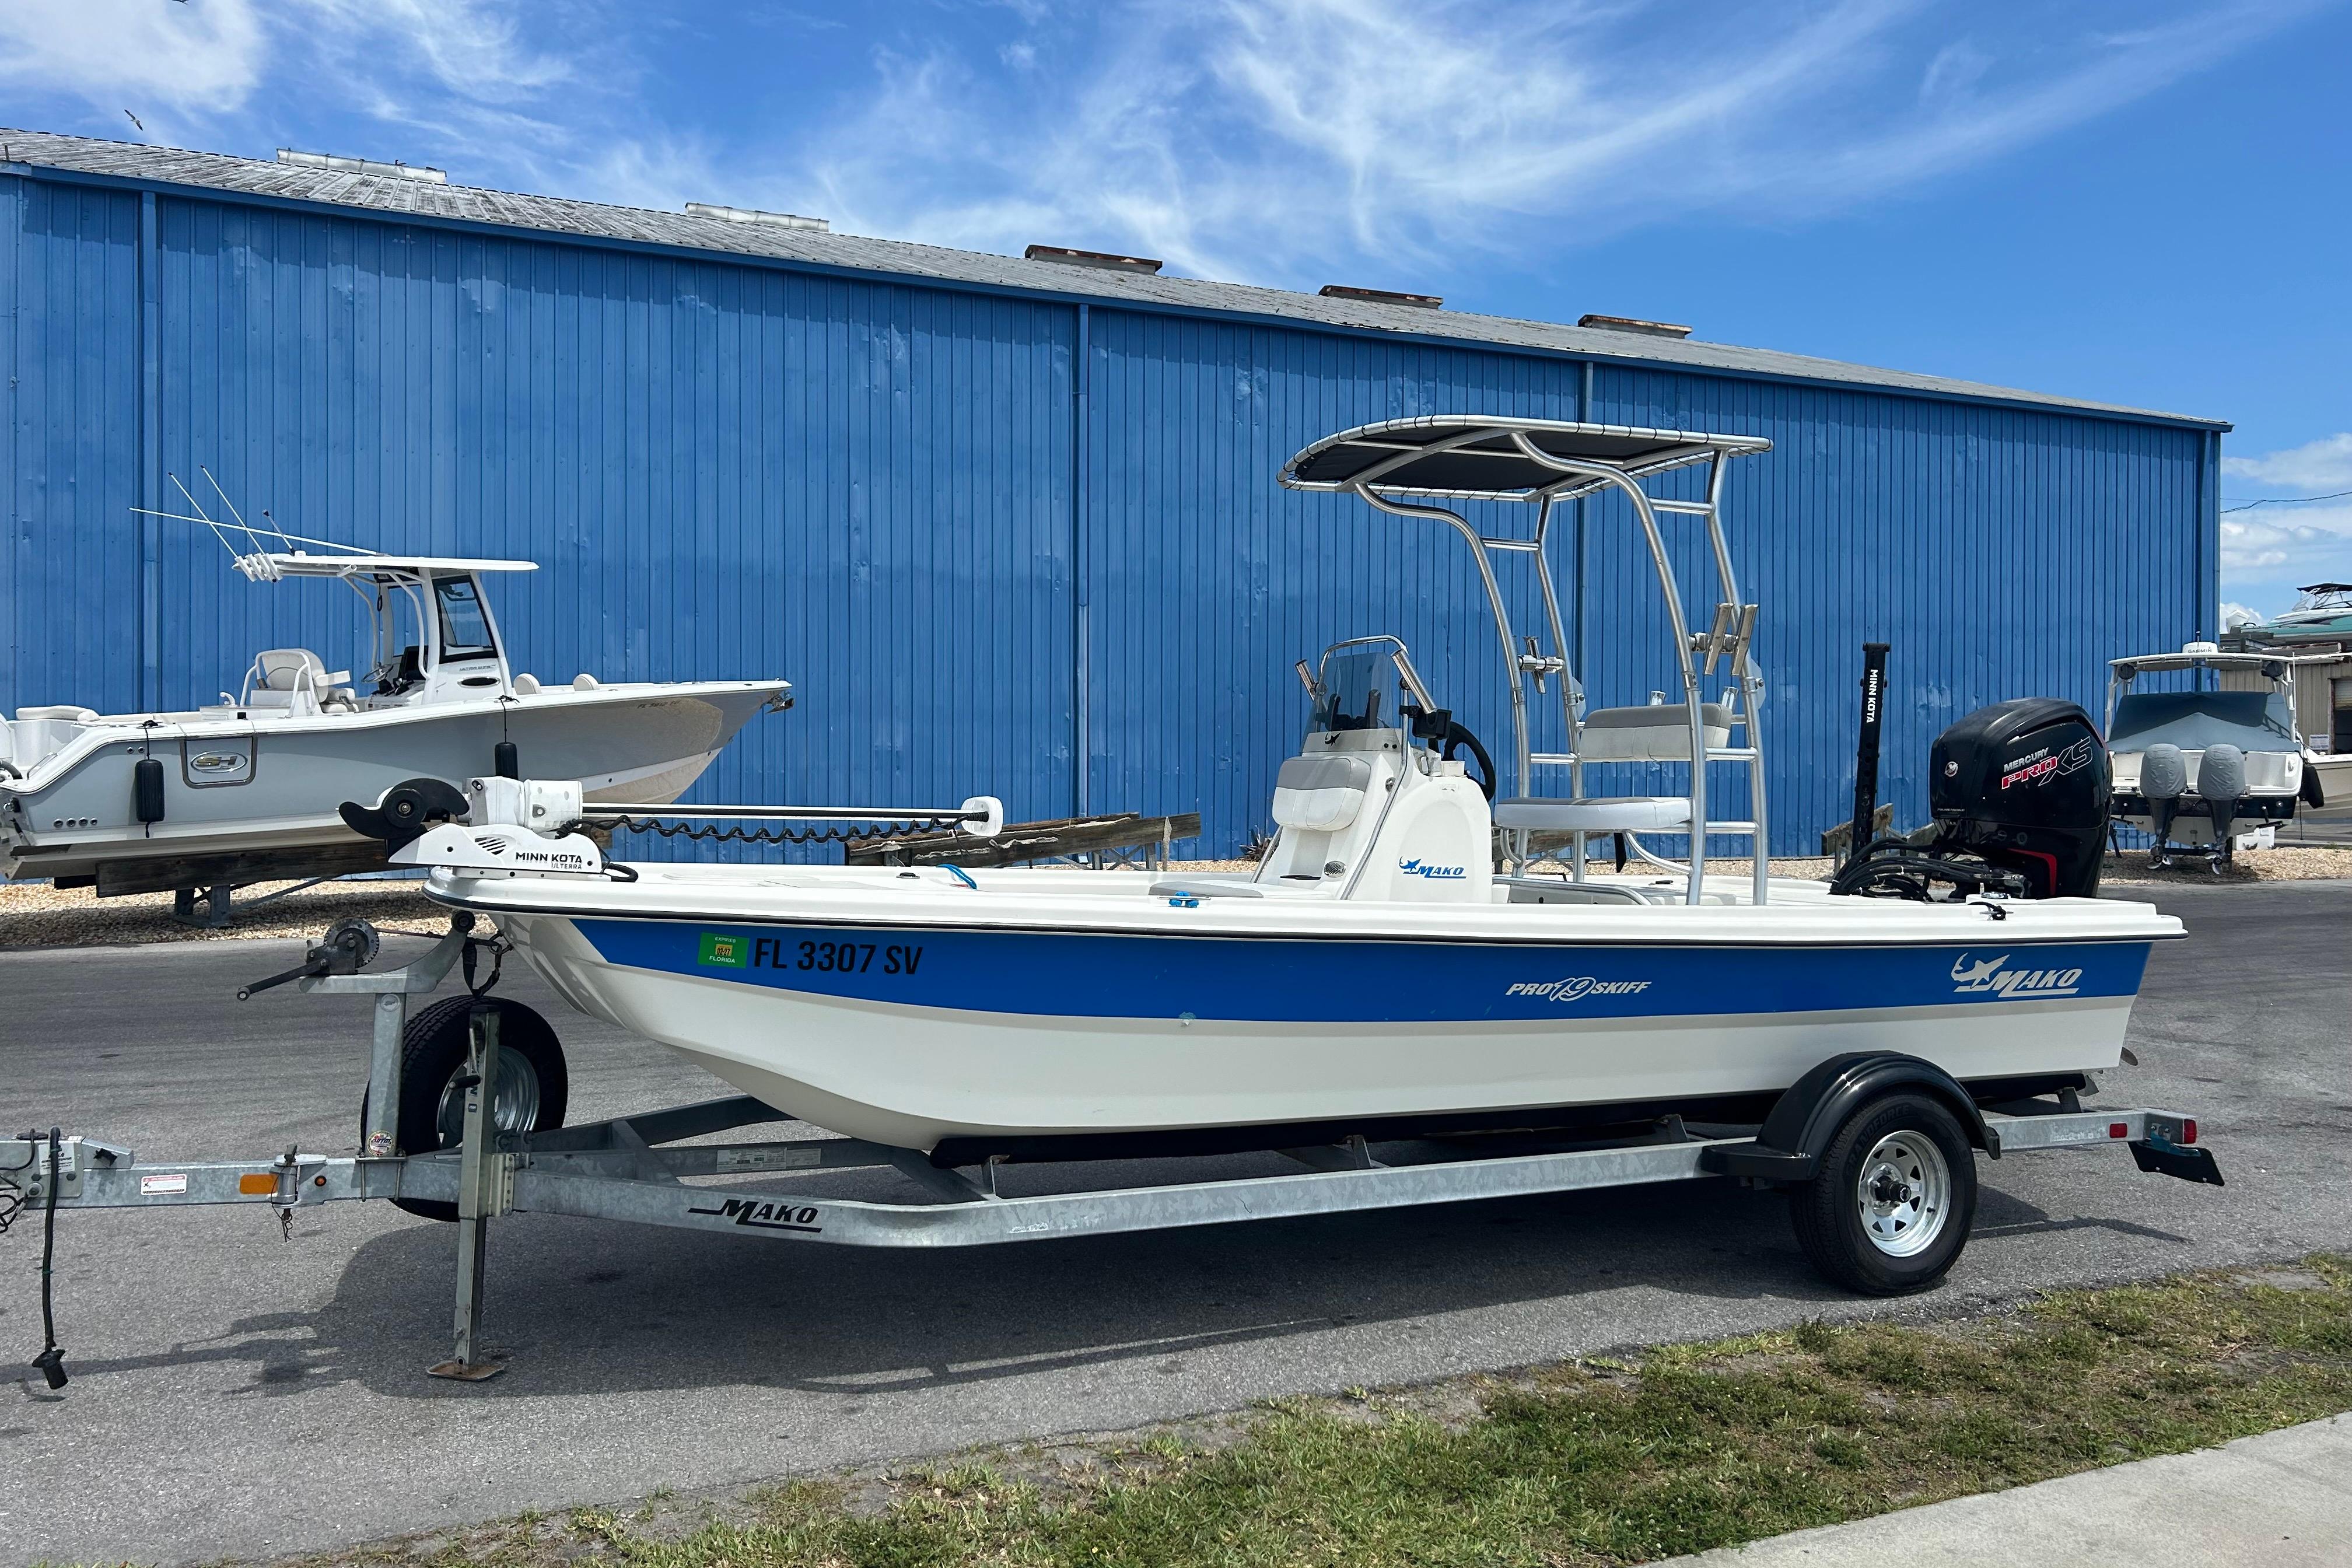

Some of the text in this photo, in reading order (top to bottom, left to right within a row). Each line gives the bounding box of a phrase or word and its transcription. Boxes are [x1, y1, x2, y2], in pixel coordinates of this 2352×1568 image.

[1867, 669, 1878, 723] MINN KOTA
[2001, 736, 2094, 790] PRO XS
[2003, 747, 2049, 773] MERCURY
[515, 852, 582, 863] MINN KOTA
[1417, 865, 1466, 879] MAKO
[709, 956, 736, 964] FLORIDA
[754, 937, 923, 975] FL 3307 SV
[1988, 968, 2082, 998] MAKO
[719, 1199, 822, 1233] MAKO
